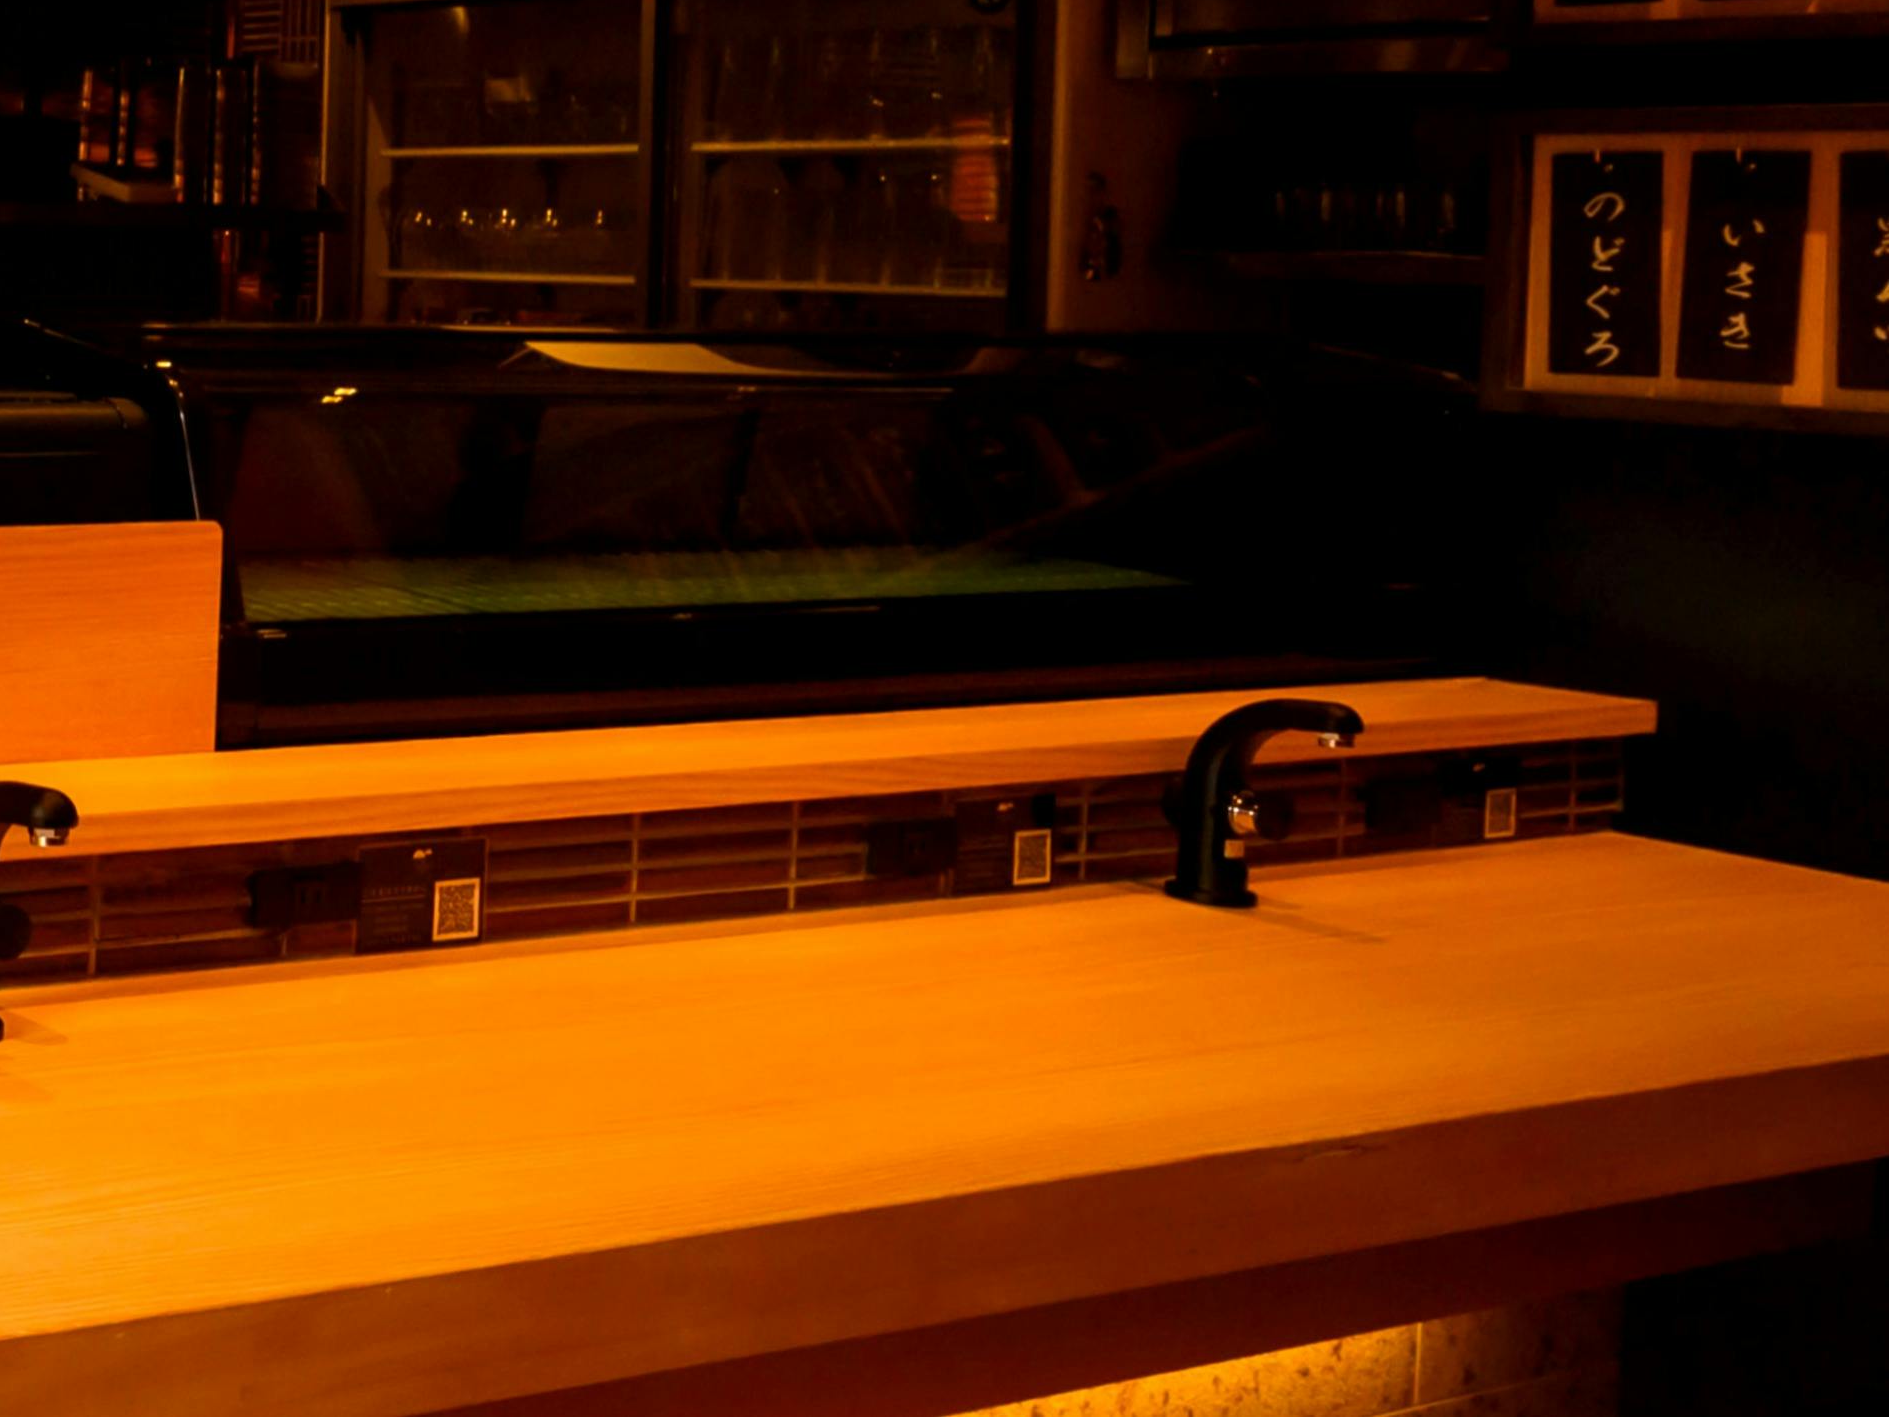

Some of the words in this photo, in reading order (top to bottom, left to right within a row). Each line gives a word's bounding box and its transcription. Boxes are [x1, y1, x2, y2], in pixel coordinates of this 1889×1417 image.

[1582, 191, 1626, 368] のどぐろ
[1718, 218, 1766, 351] いさき
